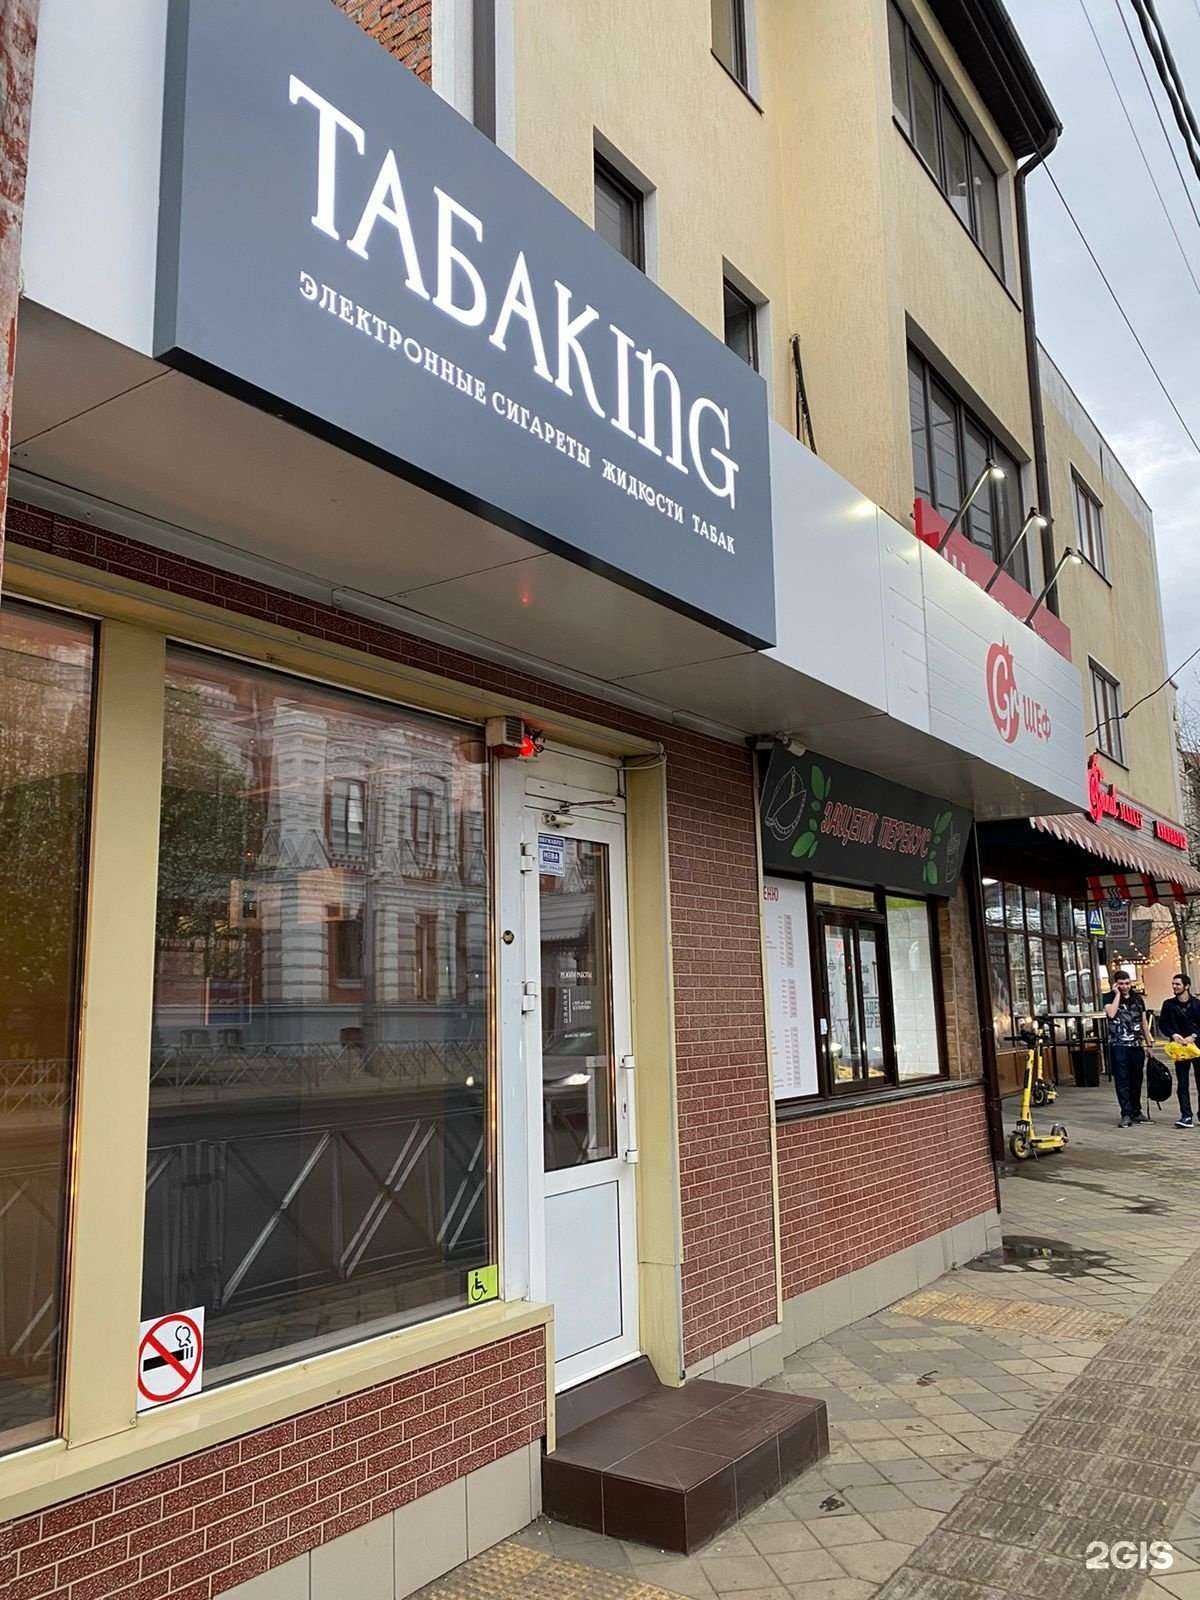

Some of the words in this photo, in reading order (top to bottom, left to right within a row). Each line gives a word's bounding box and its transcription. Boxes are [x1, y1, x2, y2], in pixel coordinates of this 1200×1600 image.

[299, 270, 486, 404] ЭЛЕКТРОННЫЕ
[492, 391, 591, 469] СИГАРЕТЫ
[602, 457, 684, 525] ЖИДКОСТИ
[692, 513, 736, 555] ТАБАК
[1022, 693, 1052, 743] ШЕФ
[820, 800, 880, 846] ЗАЦЕПИ
[877, 815, 933, 858] ПЕРЕКУС
